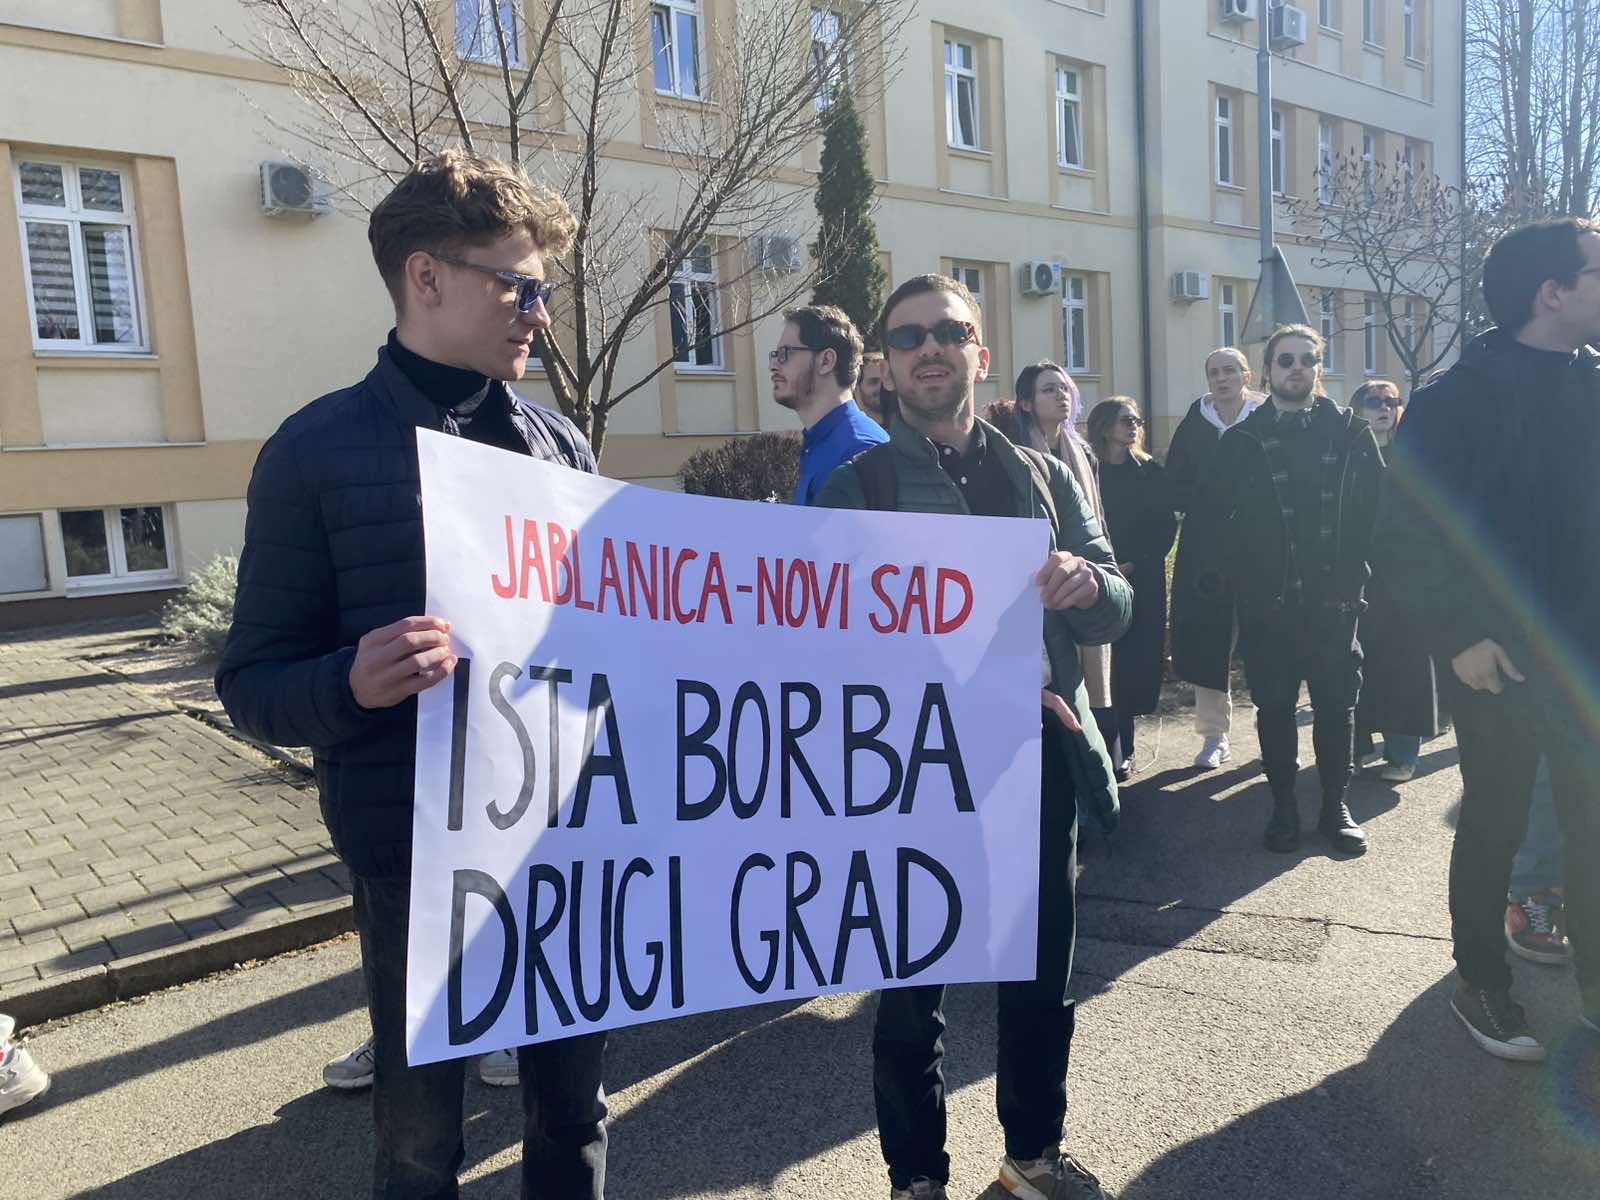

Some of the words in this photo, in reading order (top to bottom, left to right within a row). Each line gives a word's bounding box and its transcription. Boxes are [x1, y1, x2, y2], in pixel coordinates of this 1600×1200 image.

[491, 515, 849, 630] JABLANICA-NOVI
[869, 564, 973, 635] SAD
[447, 657, 638, 831] ISTA
[676, 679, 976, 821] BORBA
[448, 855, 685, 1046] DRUGI
[730, 847, 963, 994] GRAD
